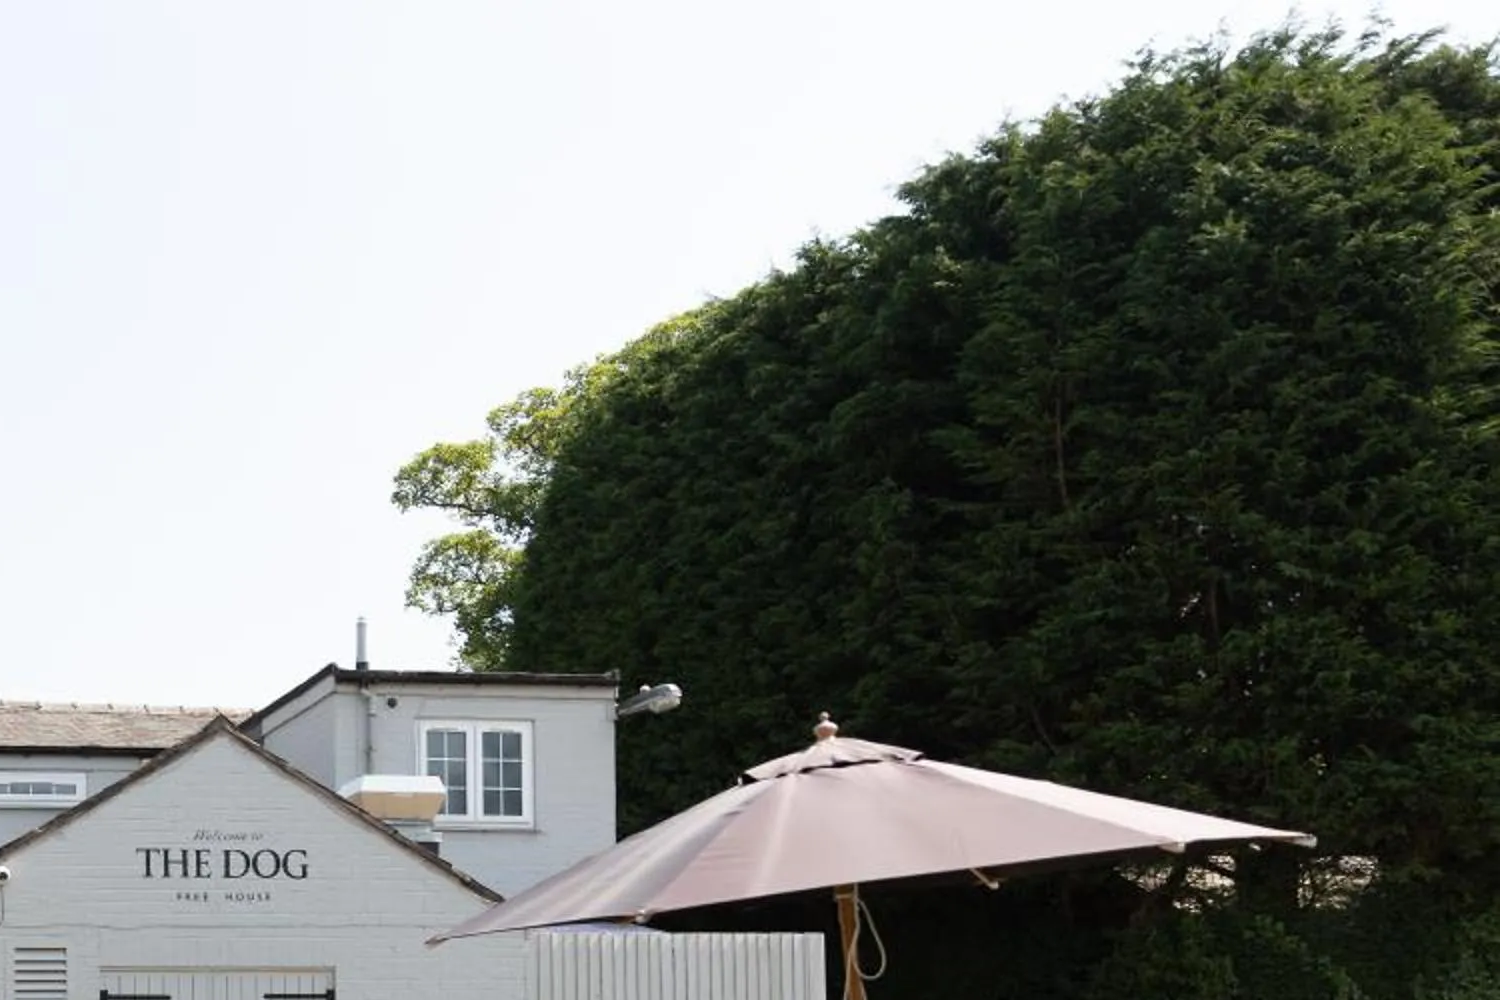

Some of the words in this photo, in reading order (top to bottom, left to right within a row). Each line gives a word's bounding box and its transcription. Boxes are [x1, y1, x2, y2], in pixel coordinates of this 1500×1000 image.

[192, 829, 247, 842] Welcome
[250, 831, 264, 842] to
[135, 848, 212, 880] THE
[223, 849, 309, 880] DOG
[176, 892, 209, 902] FREE
[225, 892, 271, 902] HOUSE
